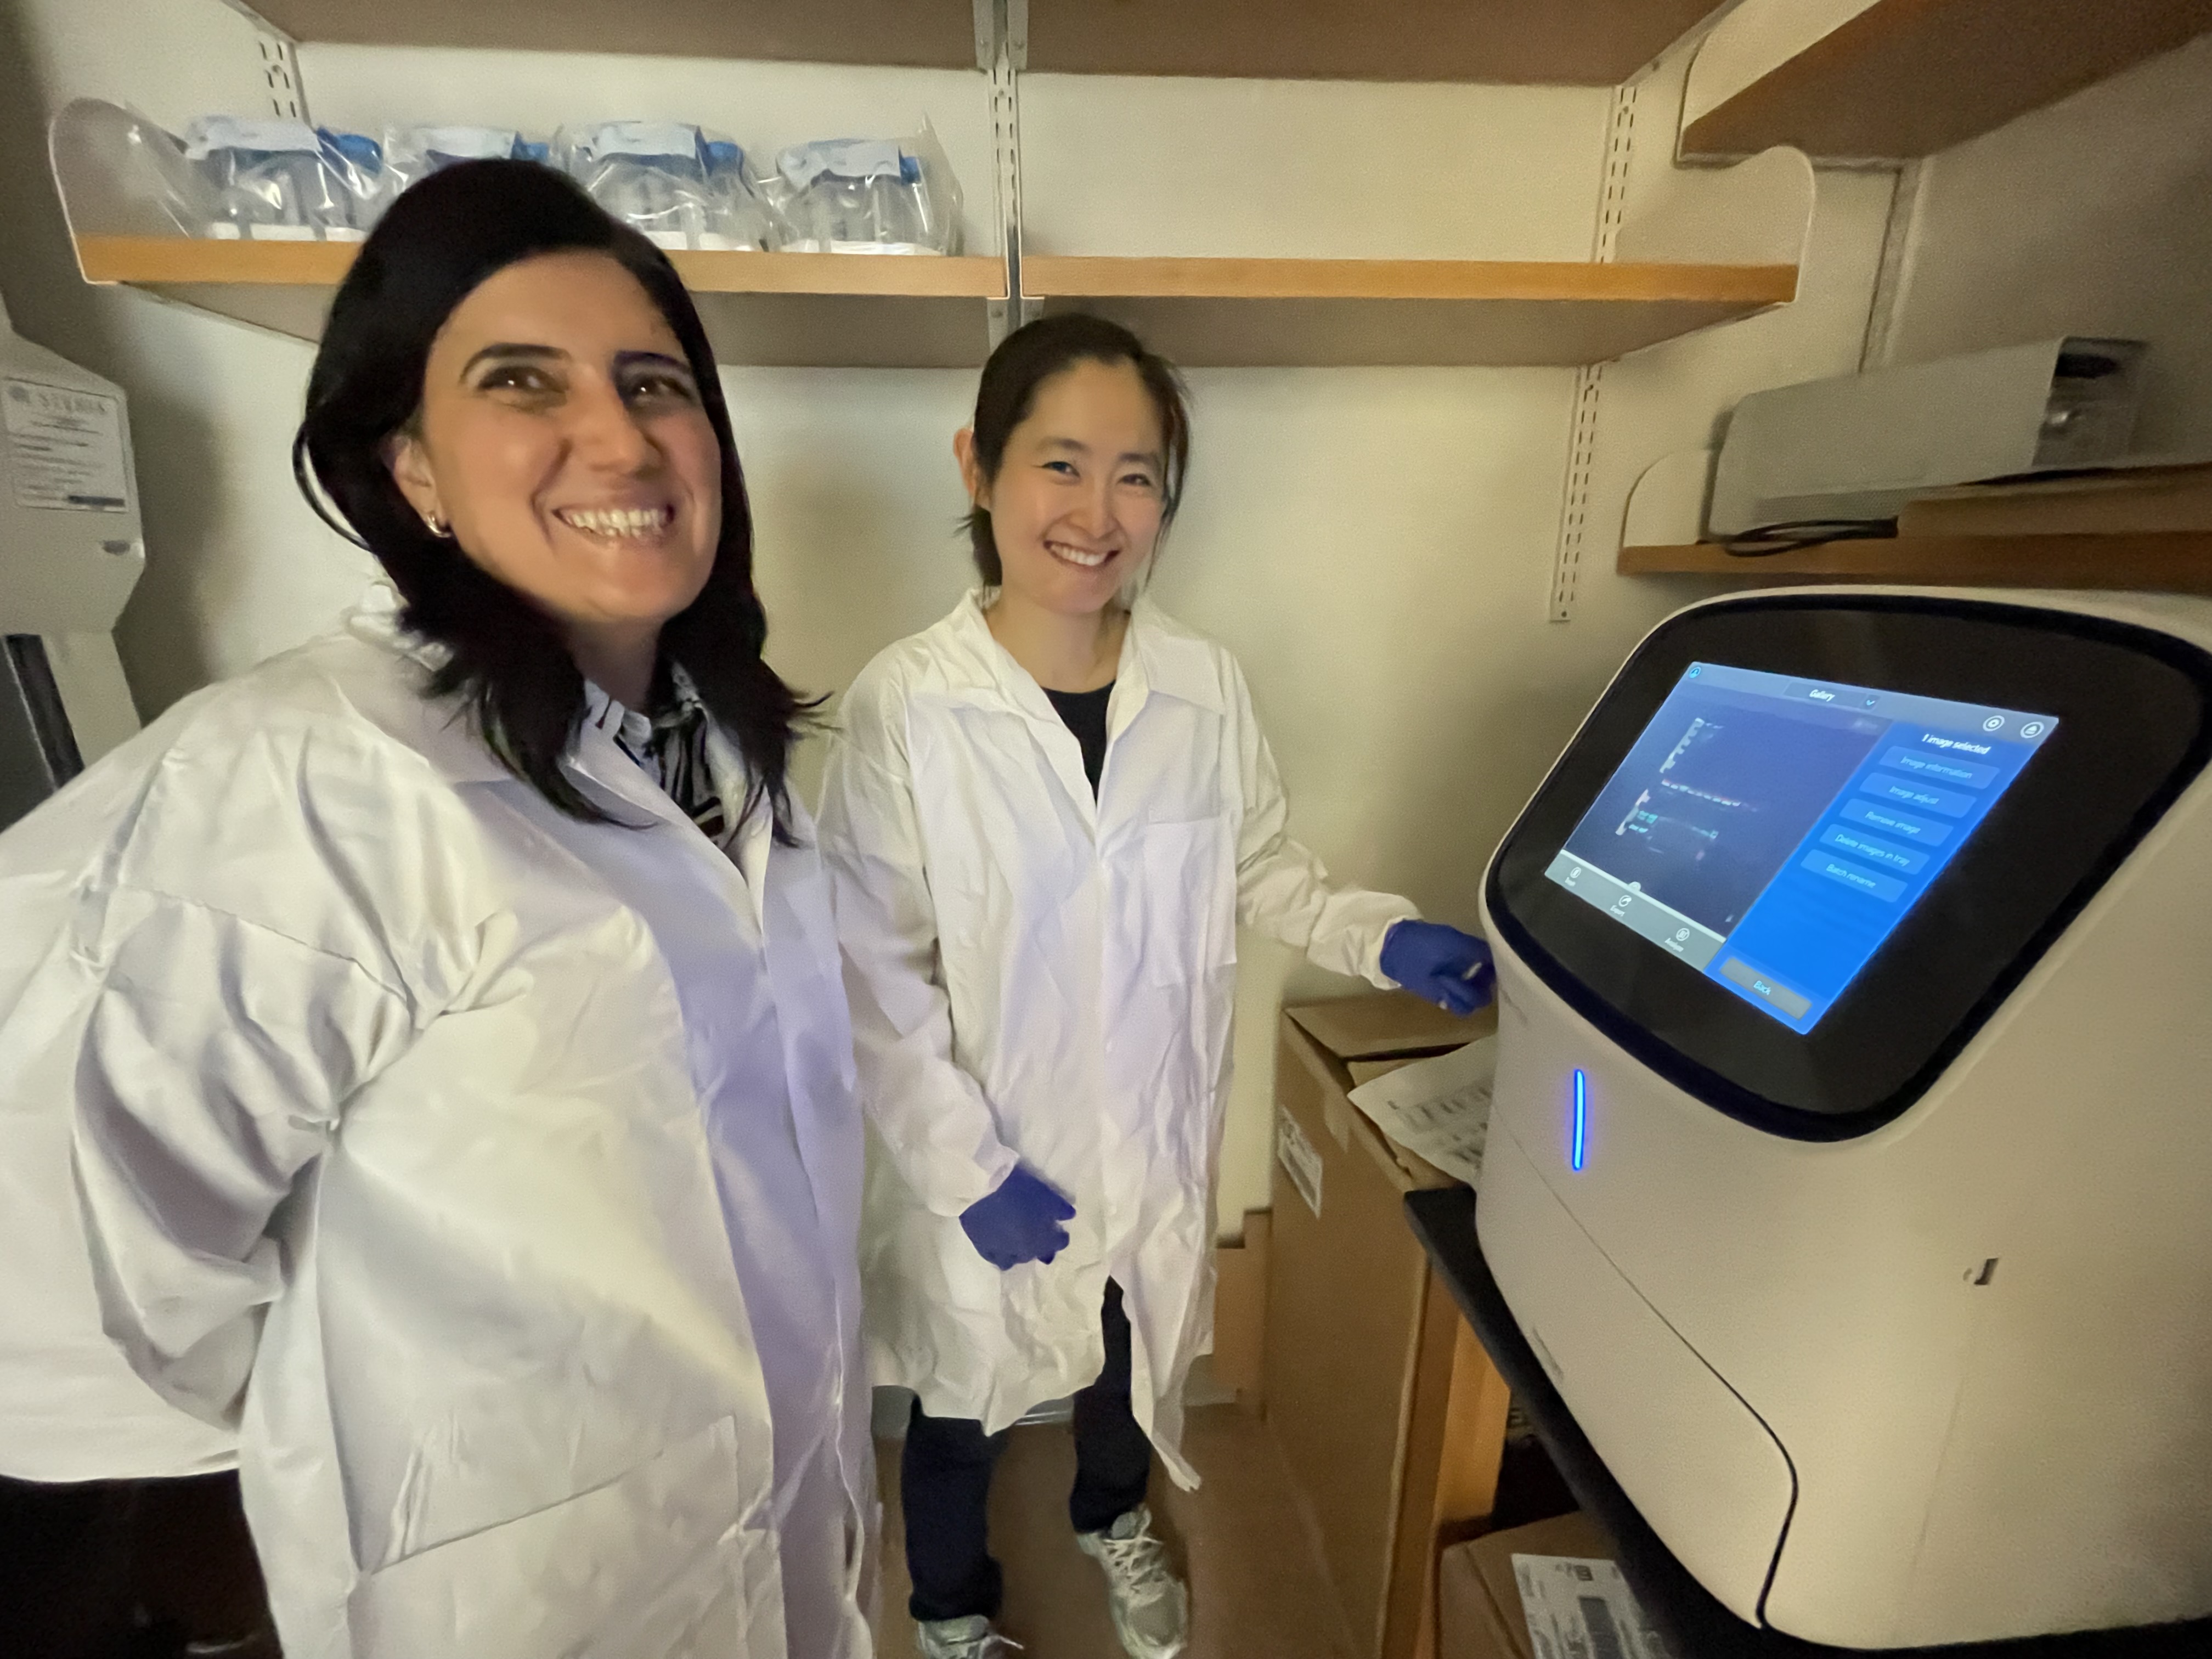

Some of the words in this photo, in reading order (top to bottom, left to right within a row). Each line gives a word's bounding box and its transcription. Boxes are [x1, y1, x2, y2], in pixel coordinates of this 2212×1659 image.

[1809, 689, 1836, 702] Gallery
[1927, 735, 1954, 748] image
[1952, 742, 1991, 755] selected
[1900, 756, 1926, 769] Image
[1889, 786, 1915, 799] Image
[1894, 822, 1921, 834] image
[1835, 834, 1859, 848] Delete
[1857, 843, 1886, 856] images
[1893, 854, 1910, 867] tray
[1826, 864, 1848, 877] Batch
[1846, 873, 1876, 888] rename
[1753, 980, 1771, 996] Back
